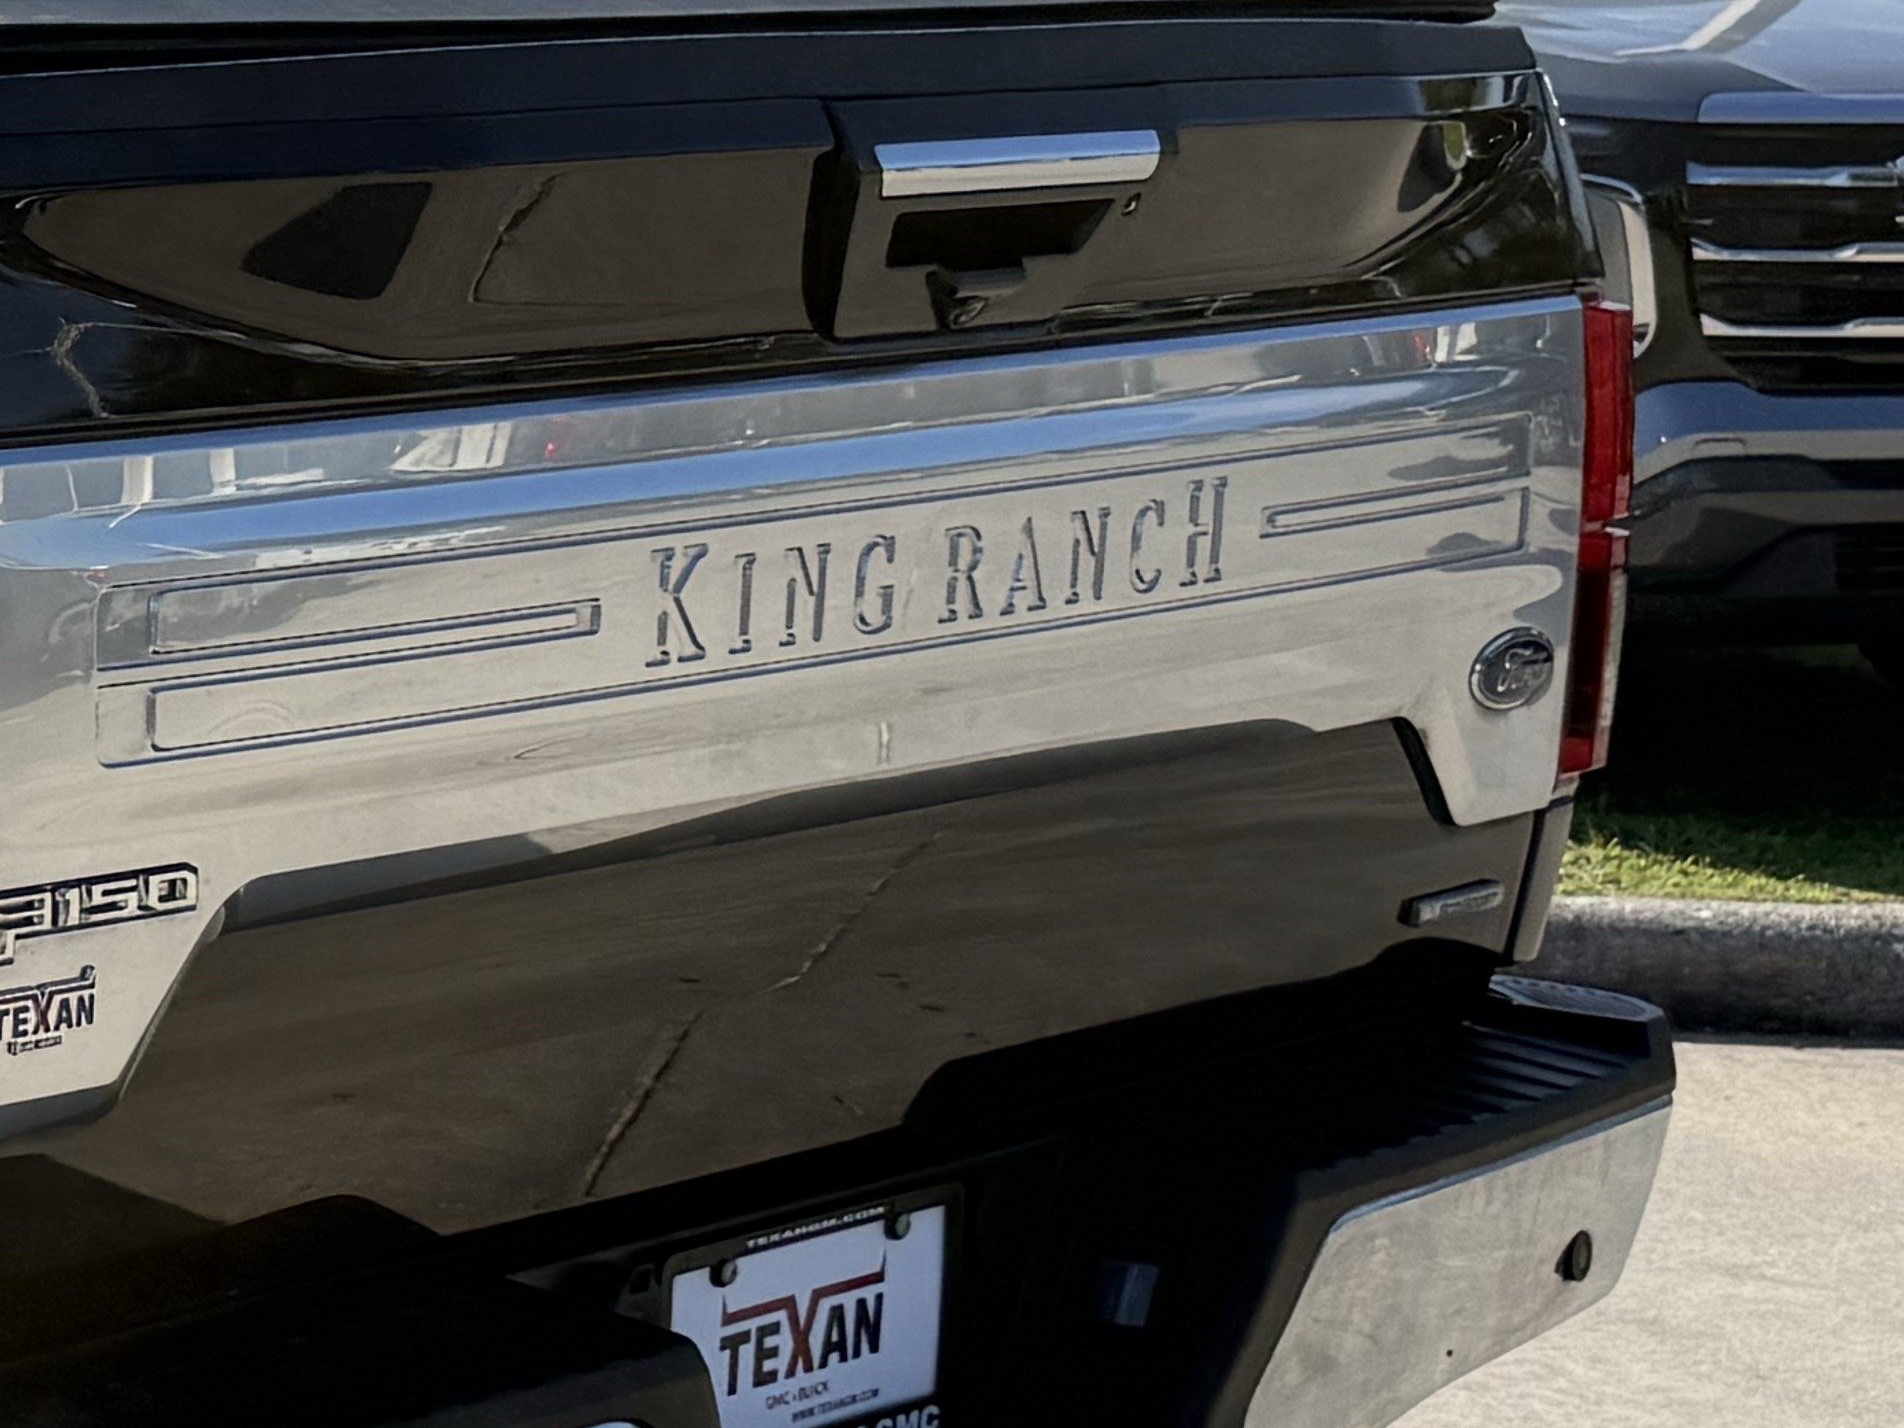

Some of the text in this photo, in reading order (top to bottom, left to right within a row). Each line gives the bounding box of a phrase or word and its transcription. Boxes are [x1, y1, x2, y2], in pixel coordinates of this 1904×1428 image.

[645, 476, 1229, 670] KING RANCH
[718, 1290, 885, 1397] TEXAN
